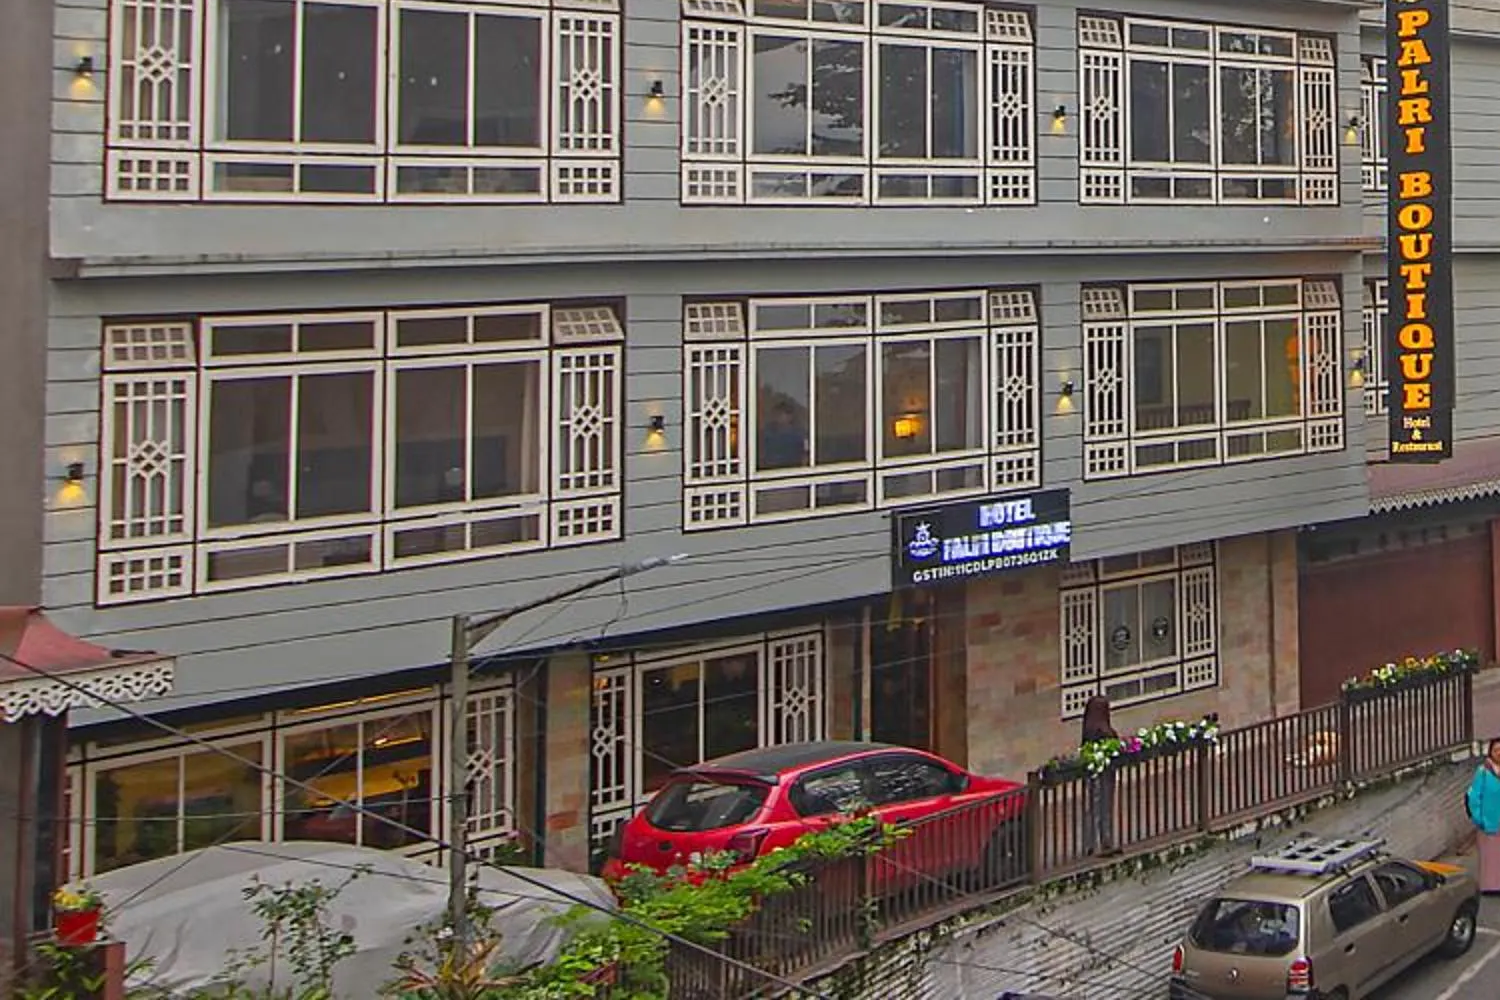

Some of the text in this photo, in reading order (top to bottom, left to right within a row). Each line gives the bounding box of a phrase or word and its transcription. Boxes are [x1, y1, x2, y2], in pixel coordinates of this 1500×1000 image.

[1397, 9, 1435, 410] PALRI BOUTIQUE
[979, 498, 1036, 527] HOTEL
